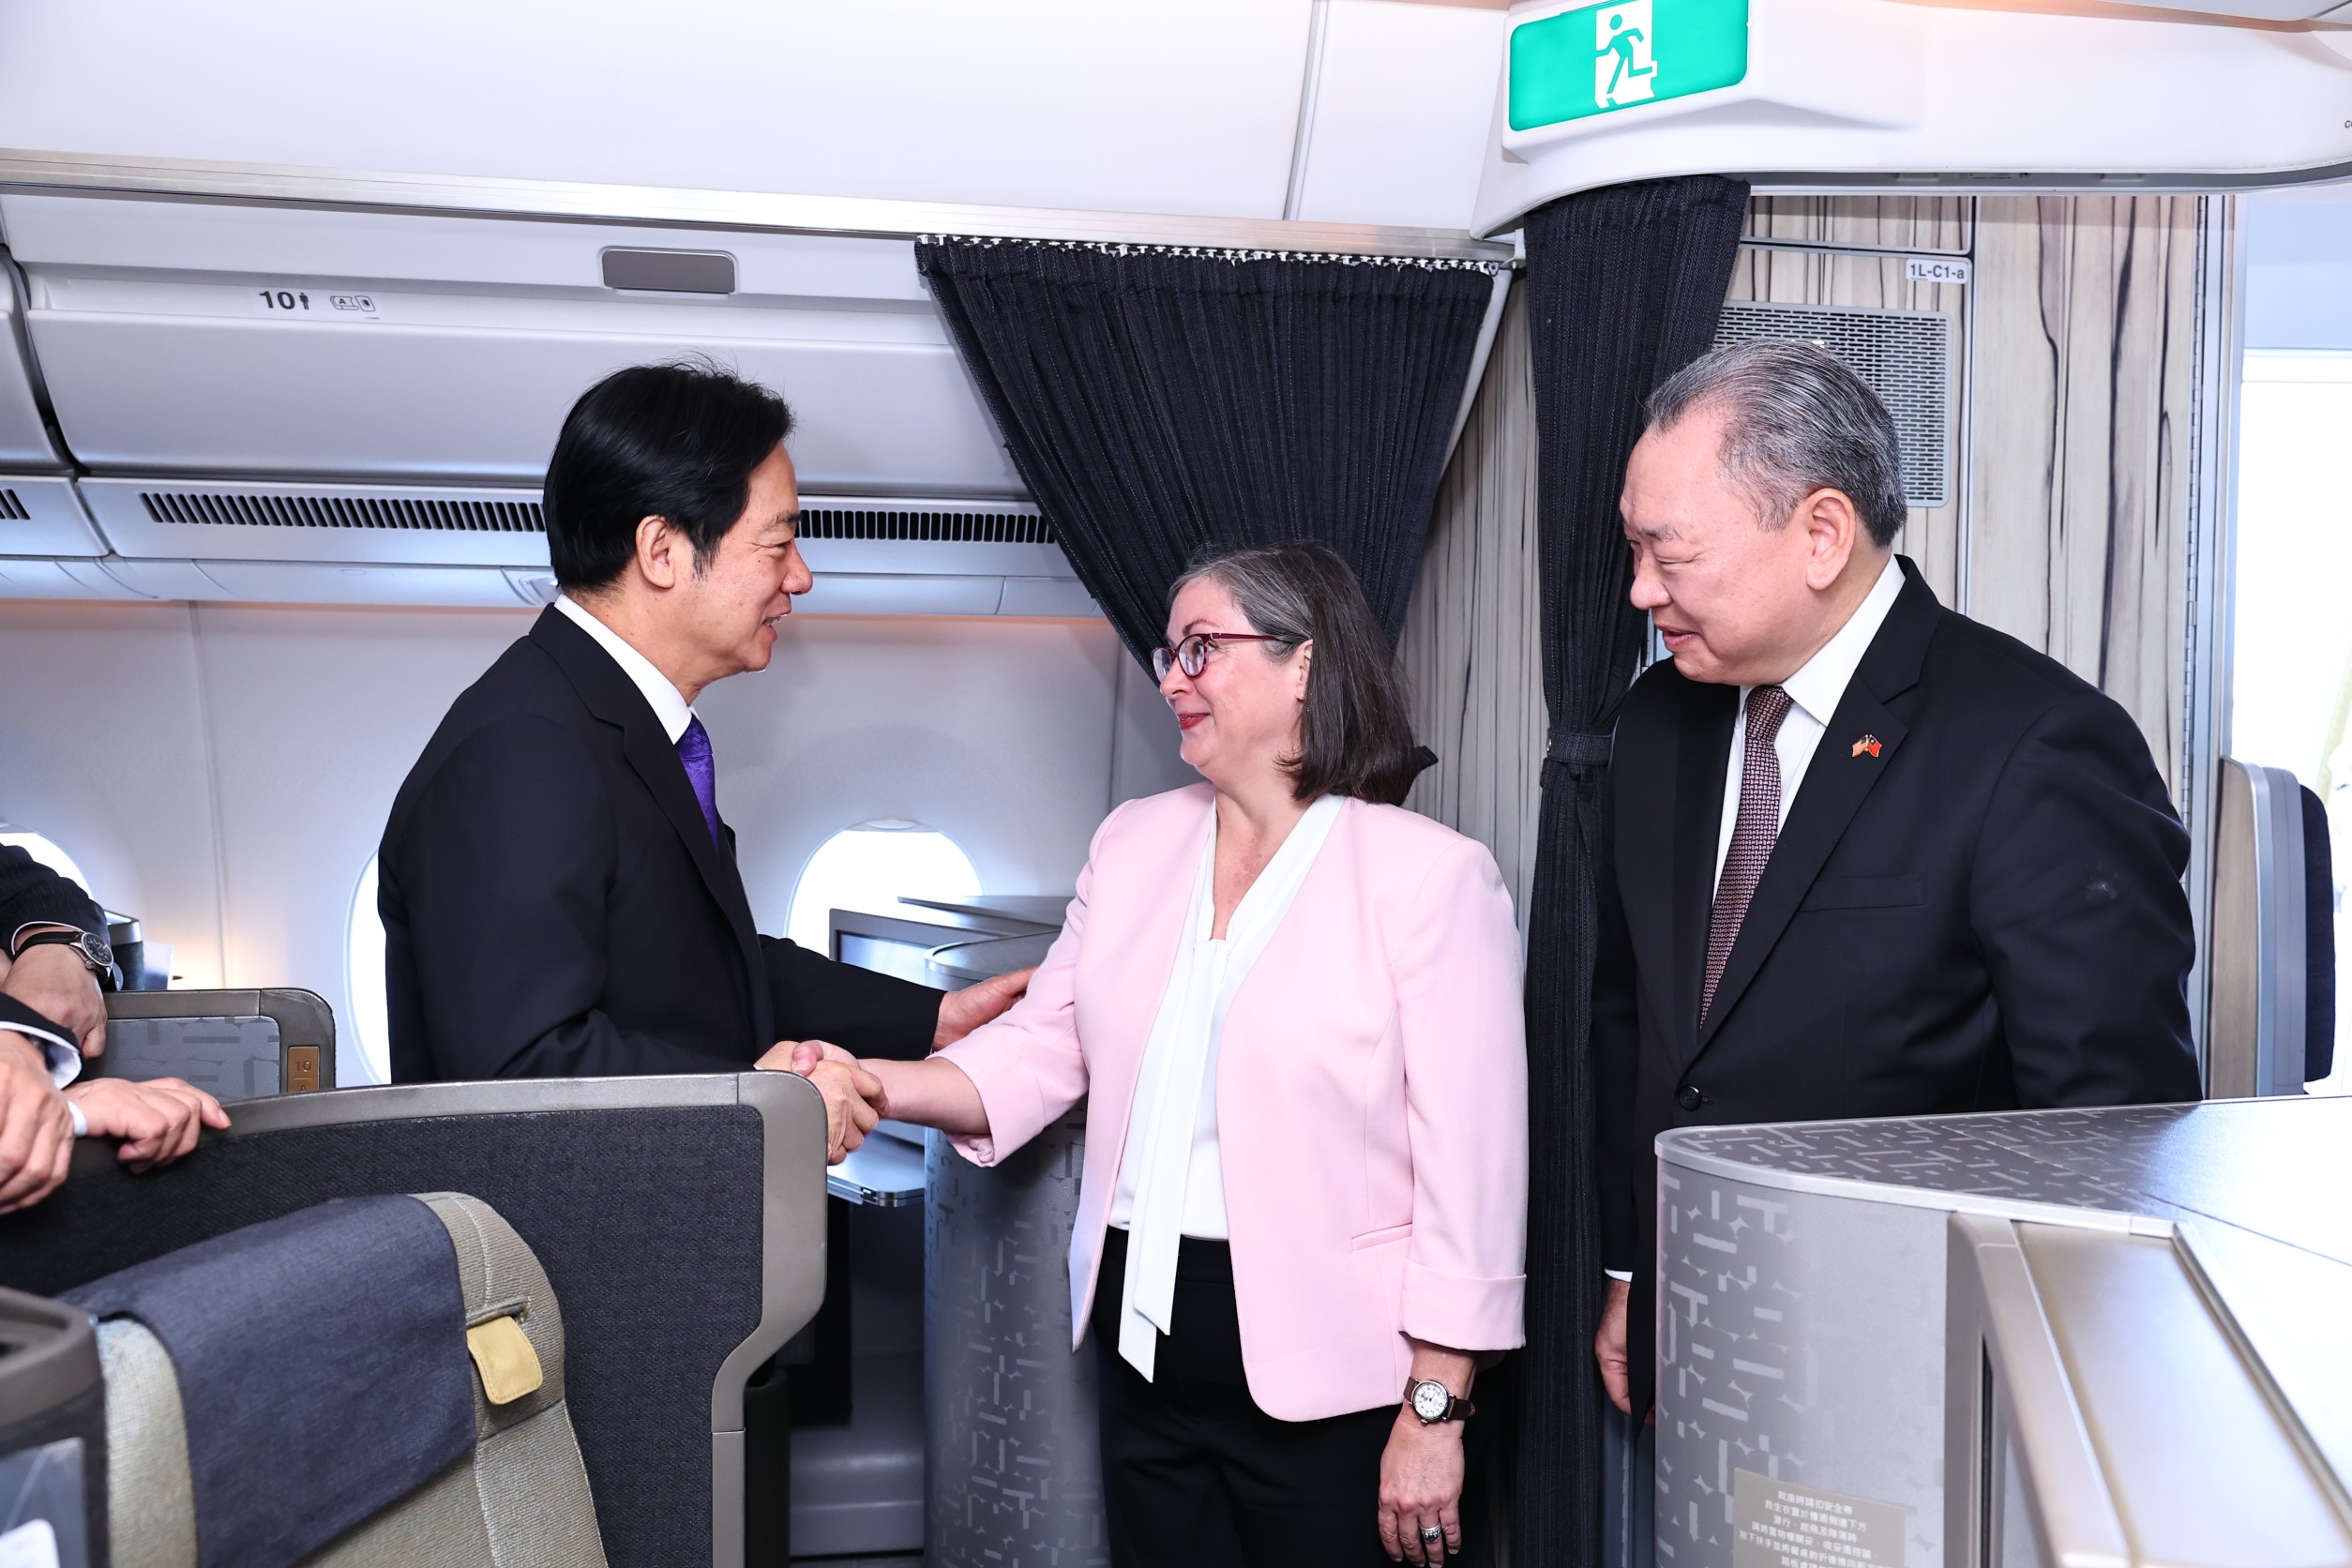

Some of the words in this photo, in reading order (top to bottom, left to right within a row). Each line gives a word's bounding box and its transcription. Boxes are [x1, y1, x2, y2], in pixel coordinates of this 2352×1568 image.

[1909, 264, 1965, 279] 1L-C1-a
[259, 291, 295, 310] 10
[294, 1061, 311, 1073] 10
